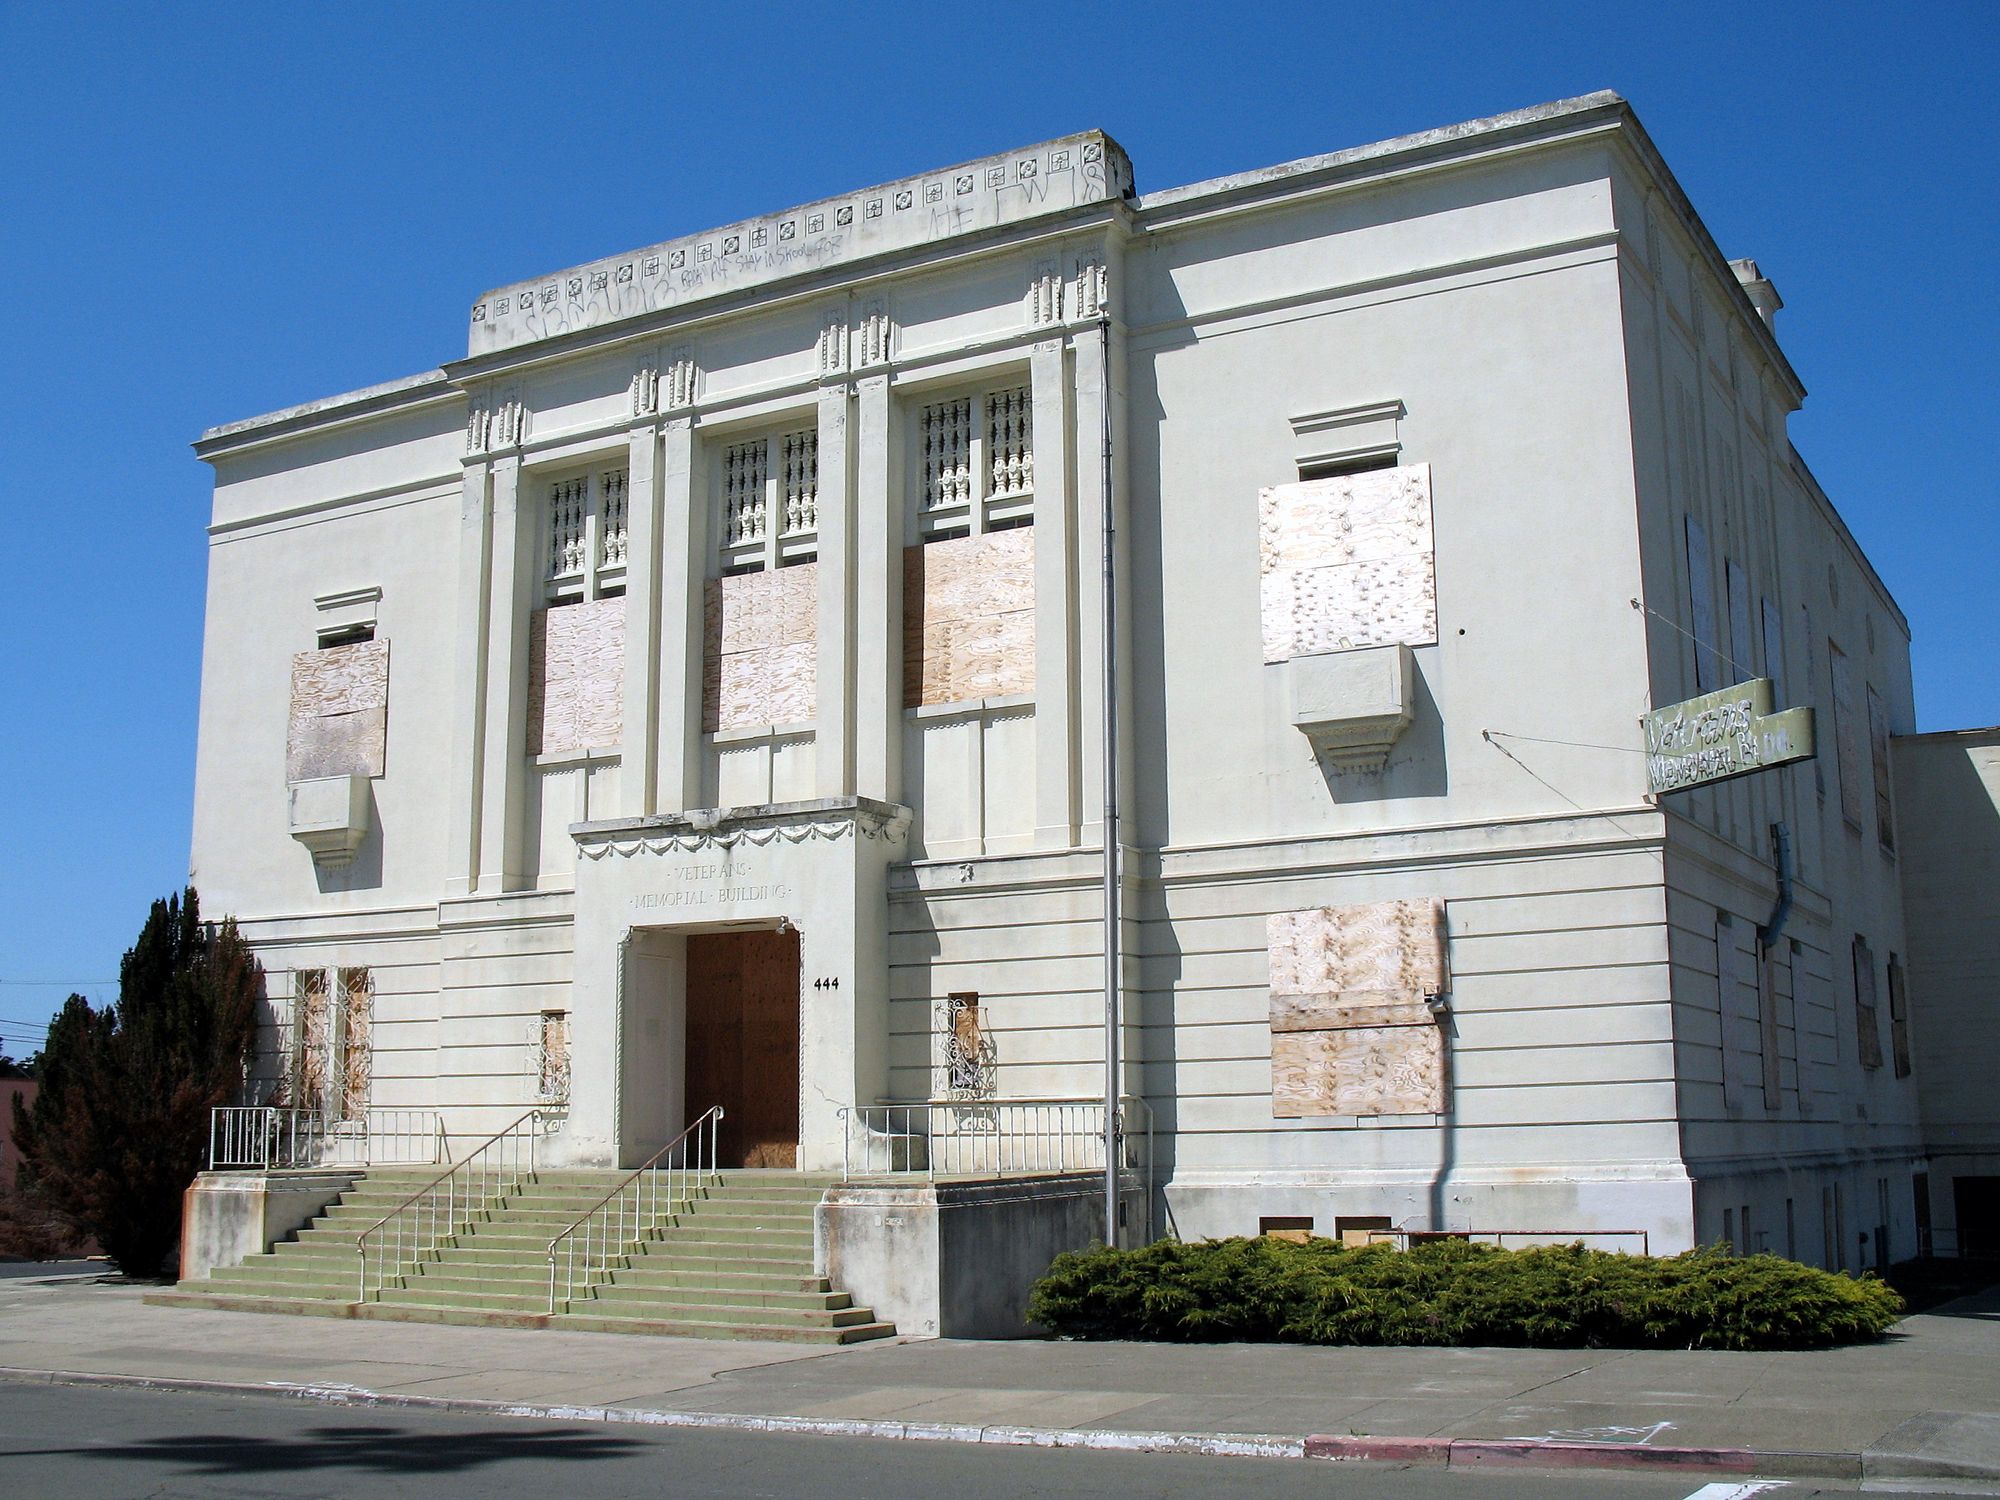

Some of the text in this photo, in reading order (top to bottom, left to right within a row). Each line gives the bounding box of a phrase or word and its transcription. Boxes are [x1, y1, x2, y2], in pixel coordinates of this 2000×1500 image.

[674, 862, 747, 881] VETERANS
[634, 884, 787, 909] MEMORIAL BUILDING
[813, 976, 839, 991] 444
